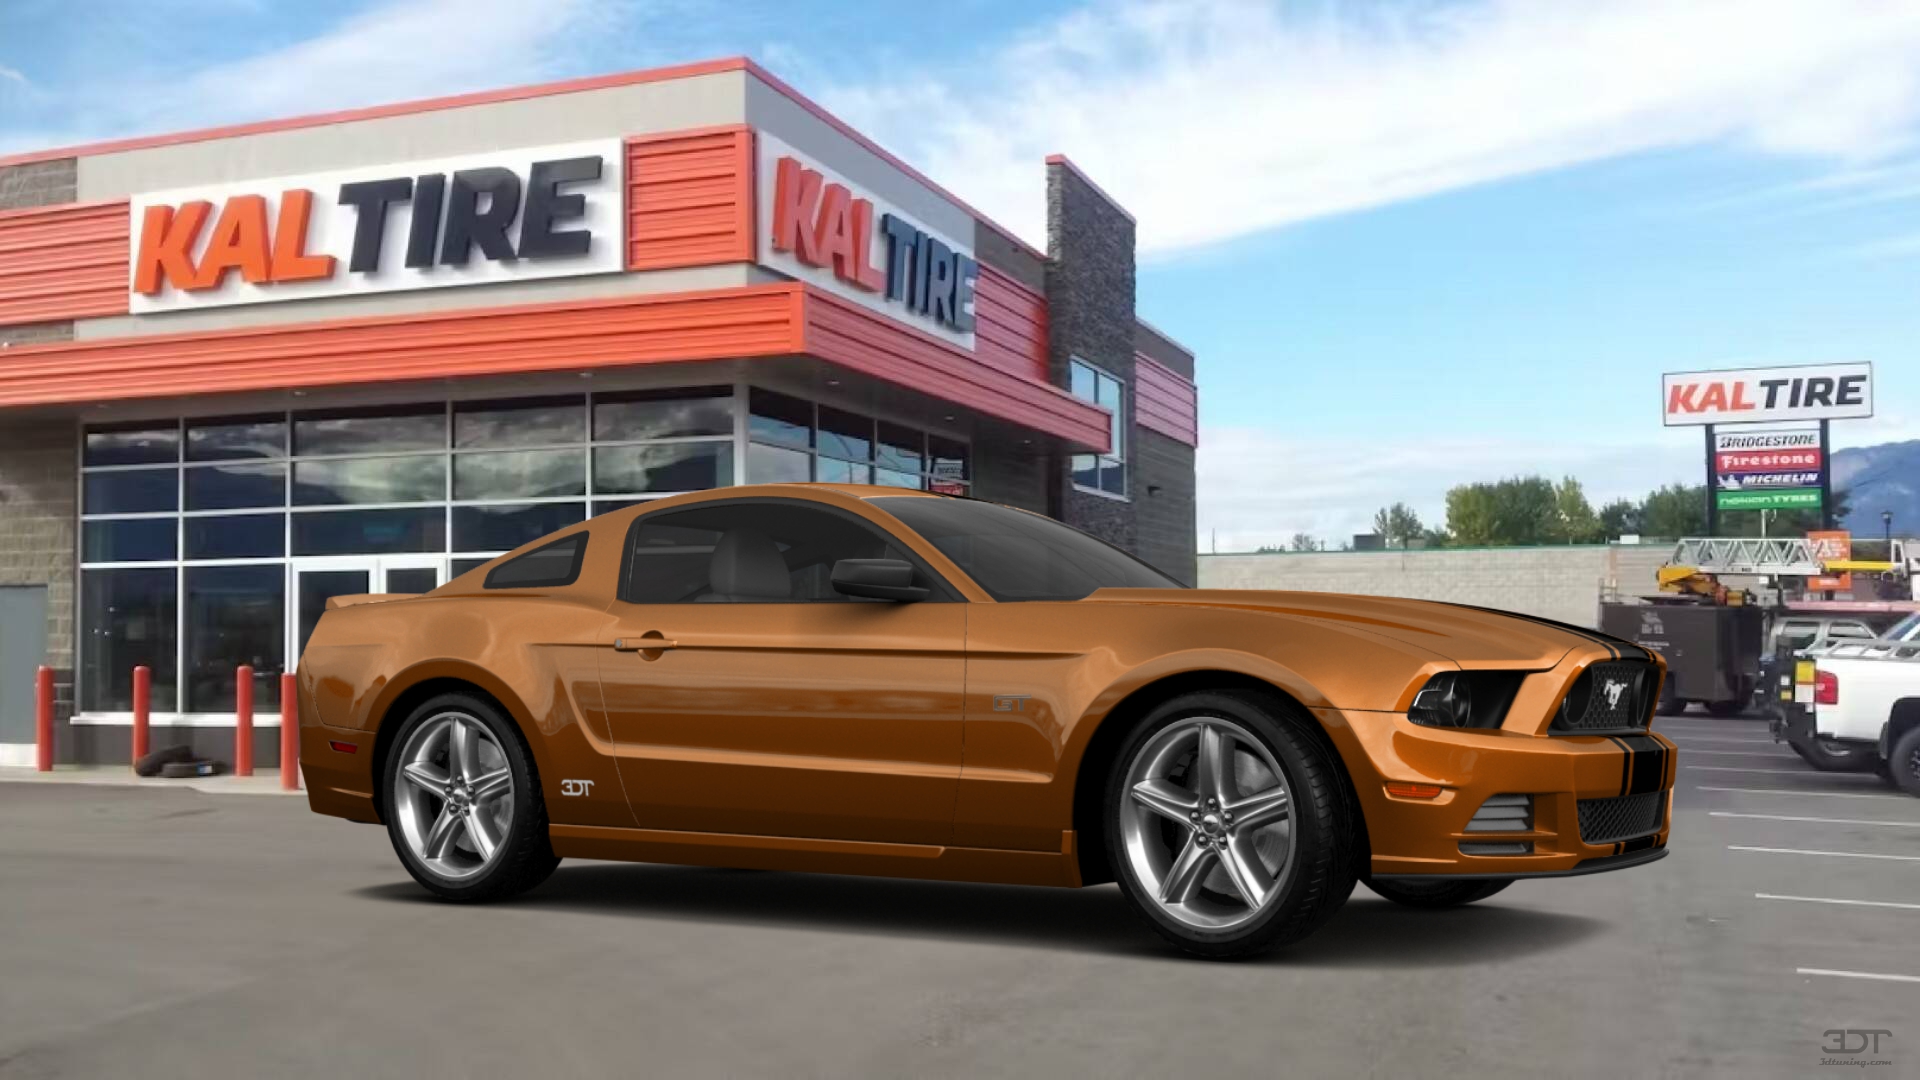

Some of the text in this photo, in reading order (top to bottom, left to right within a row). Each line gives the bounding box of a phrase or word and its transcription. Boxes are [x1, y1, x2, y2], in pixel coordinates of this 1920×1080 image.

[134, 155, 603, 295] KAL TIRE
[772, 156, 978, 334] KAL TIRE
[1667, 375, 1867, 413] KAL TIRE
[1720, 434, 1816, 448] BRIDGESTONE
[1721, 454, 1816, 469] Firestone
[1742, 473, 1818, 484] MICHELIN
[993, 694, 1032, 711] GT
